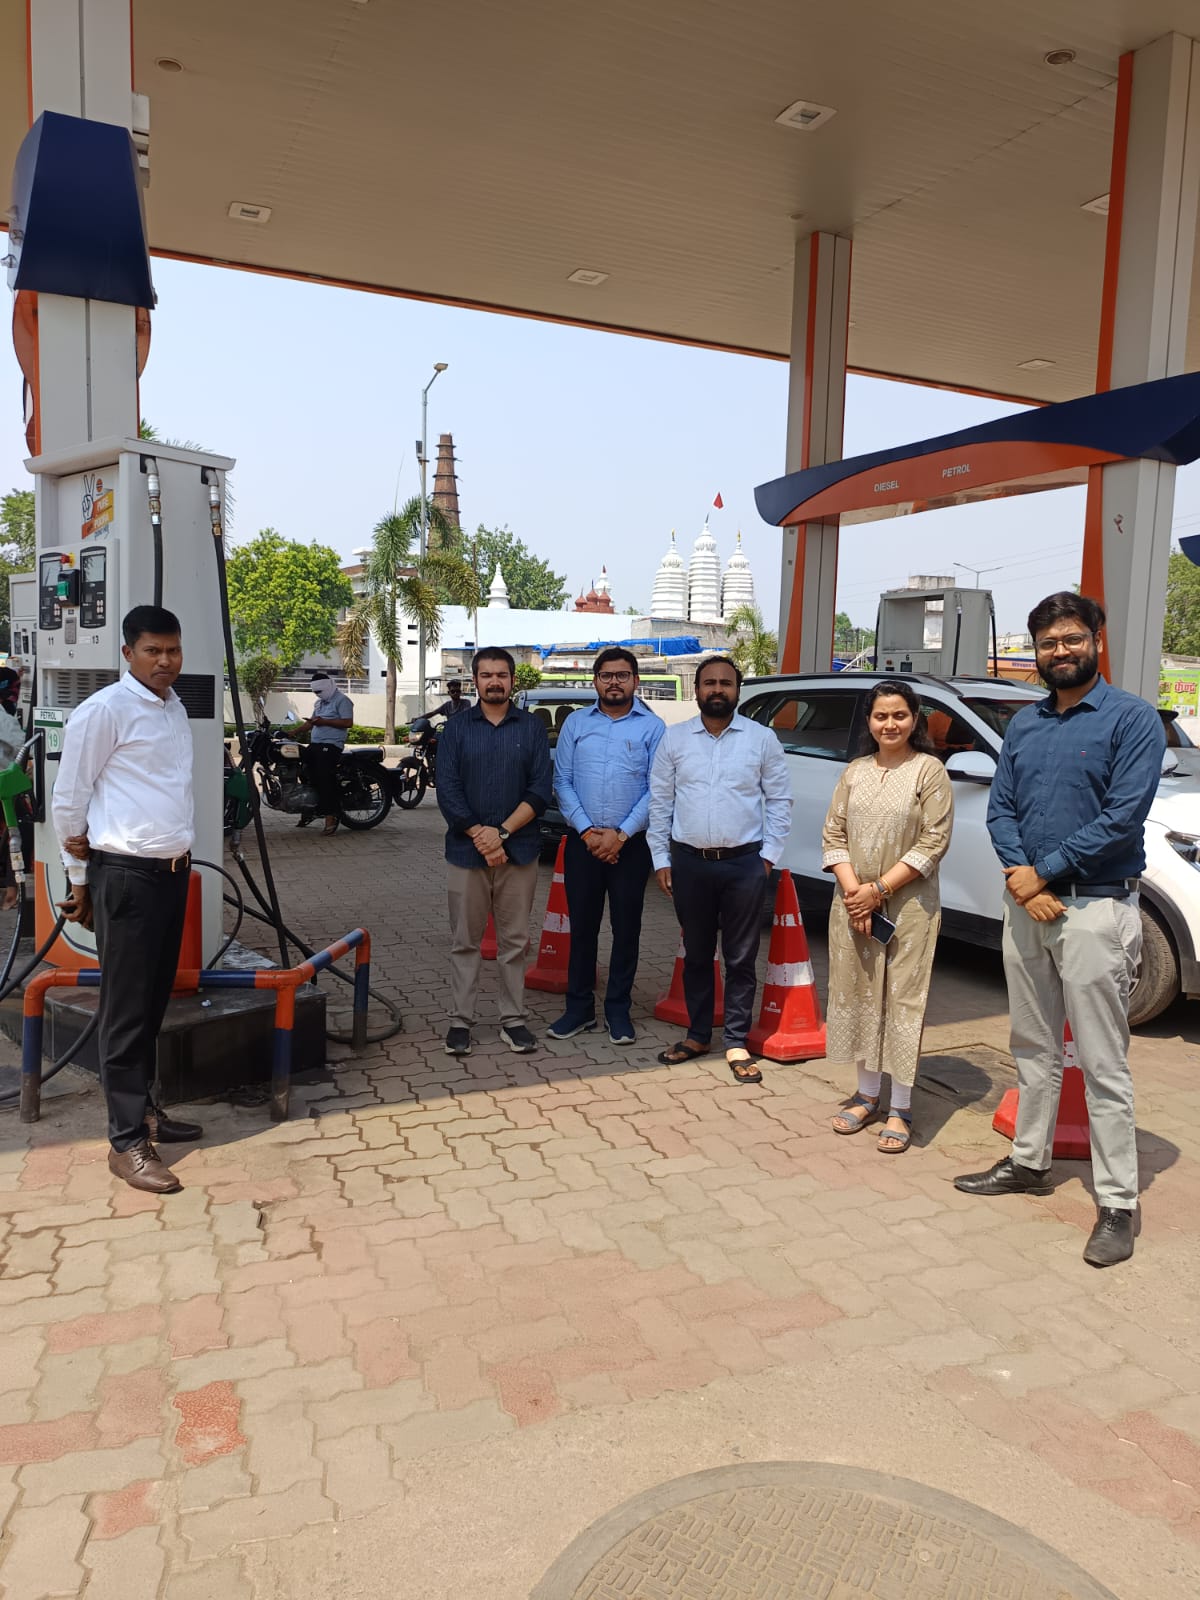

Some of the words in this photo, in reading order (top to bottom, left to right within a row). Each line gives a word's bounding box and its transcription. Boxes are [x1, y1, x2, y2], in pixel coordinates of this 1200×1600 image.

[942, 463, 970, 478] PETROL
[874, 480, 899, 492] DIESEL
[48, 636, 54, 646] 11
[92, 634, 99, 645] 13
[40, 711, 57, 720] PETROL
[48, 733, 58, 747] 19
